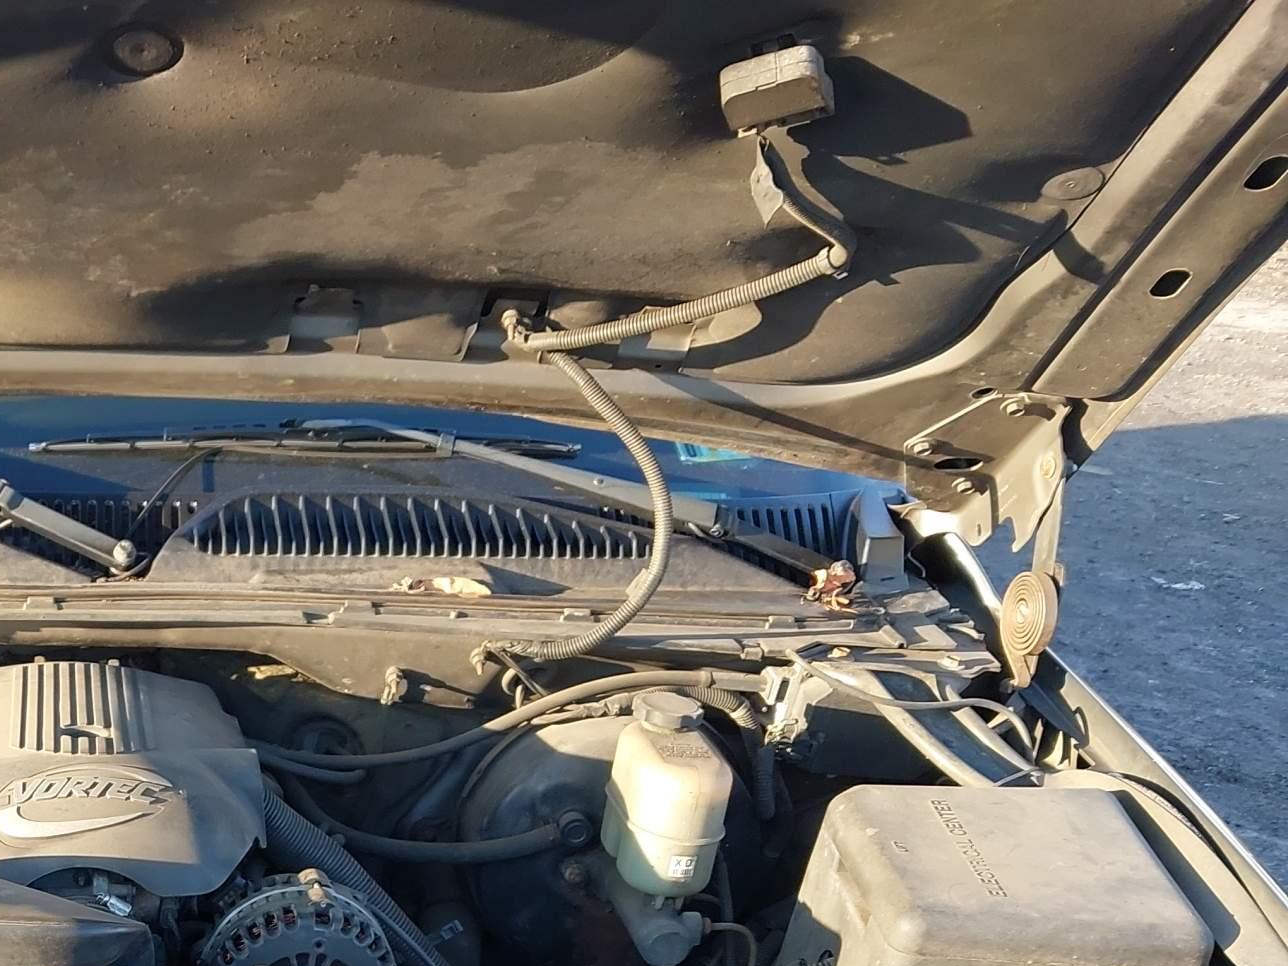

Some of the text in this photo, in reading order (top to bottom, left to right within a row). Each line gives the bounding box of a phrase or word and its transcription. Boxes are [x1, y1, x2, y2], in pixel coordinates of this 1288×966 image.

[9, 775, 172, 806] VORTEC
[930, 798, 1009, 898] ELECTRICAL CENTER
